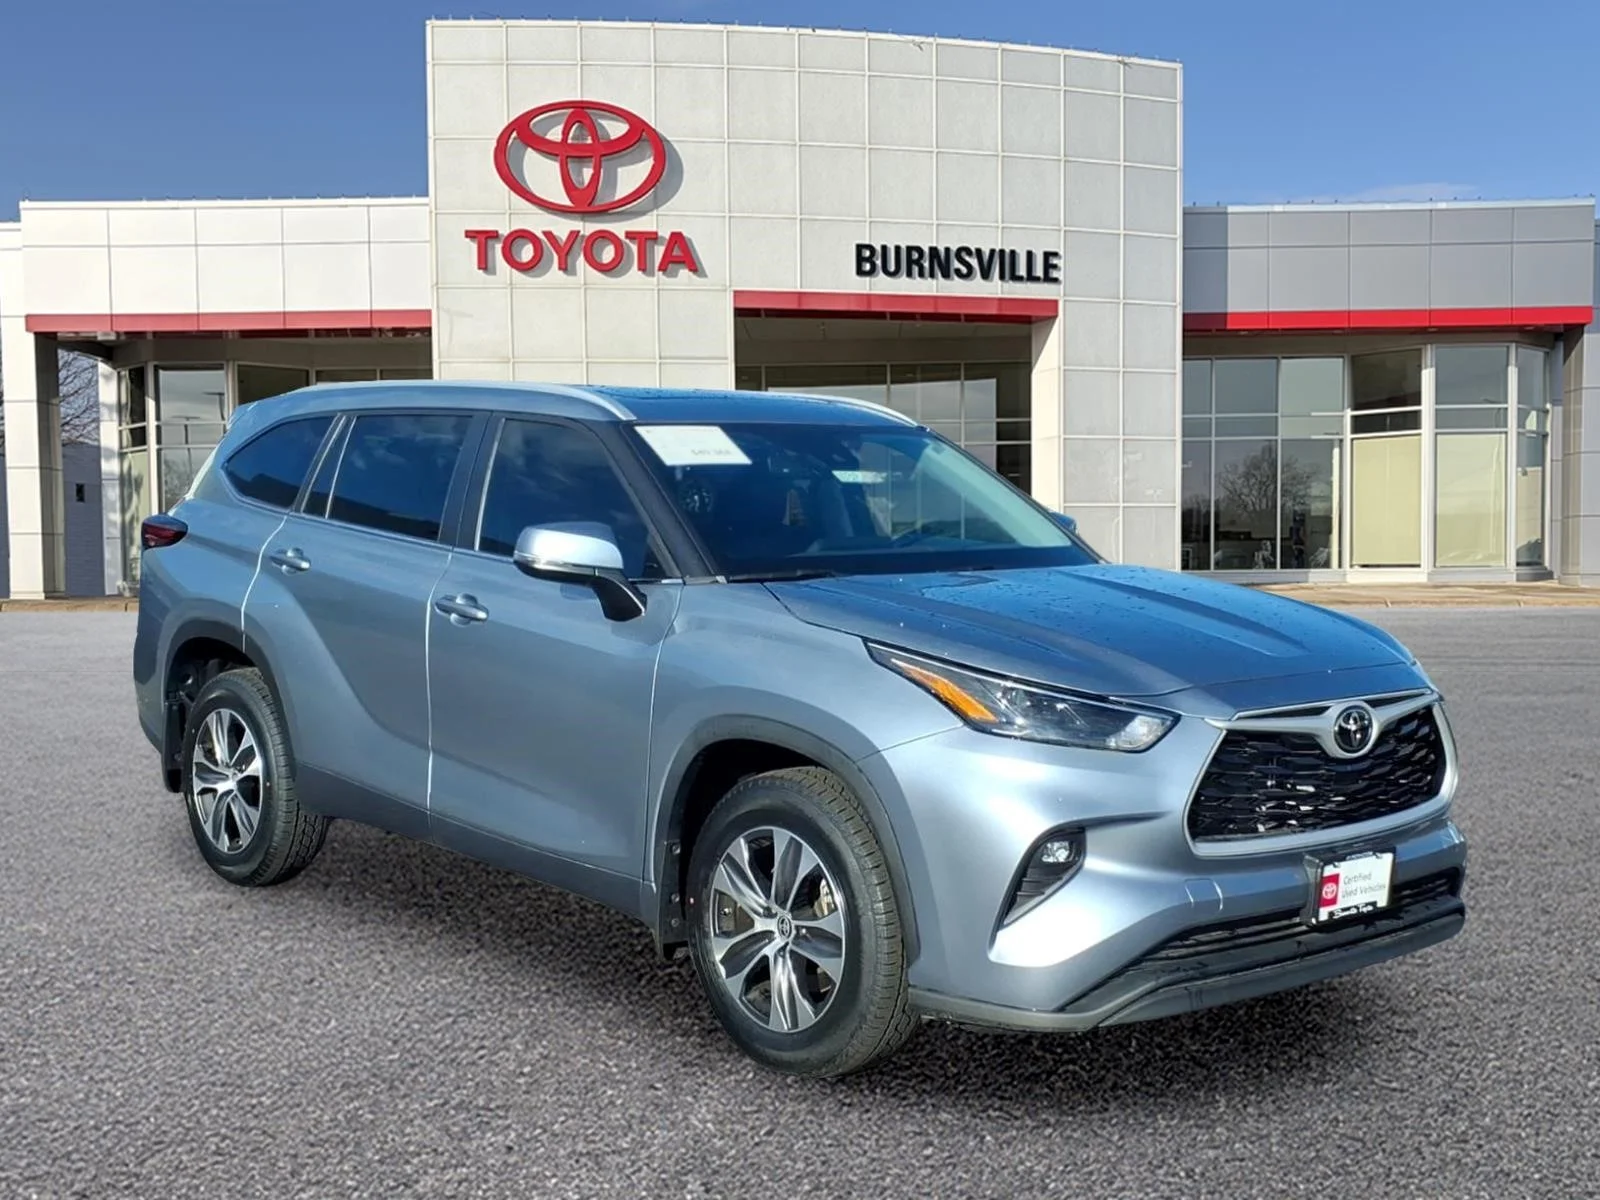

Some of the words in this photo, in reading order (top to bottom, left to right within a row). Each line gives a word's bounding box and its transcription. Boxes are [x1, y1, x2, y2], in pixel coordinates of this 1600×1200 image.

[465, 229, 700, 273] TOYOTA
[855, 243, 1061, 282] BURNSVILLE
[1343, 872, 1372, 885] Certified
